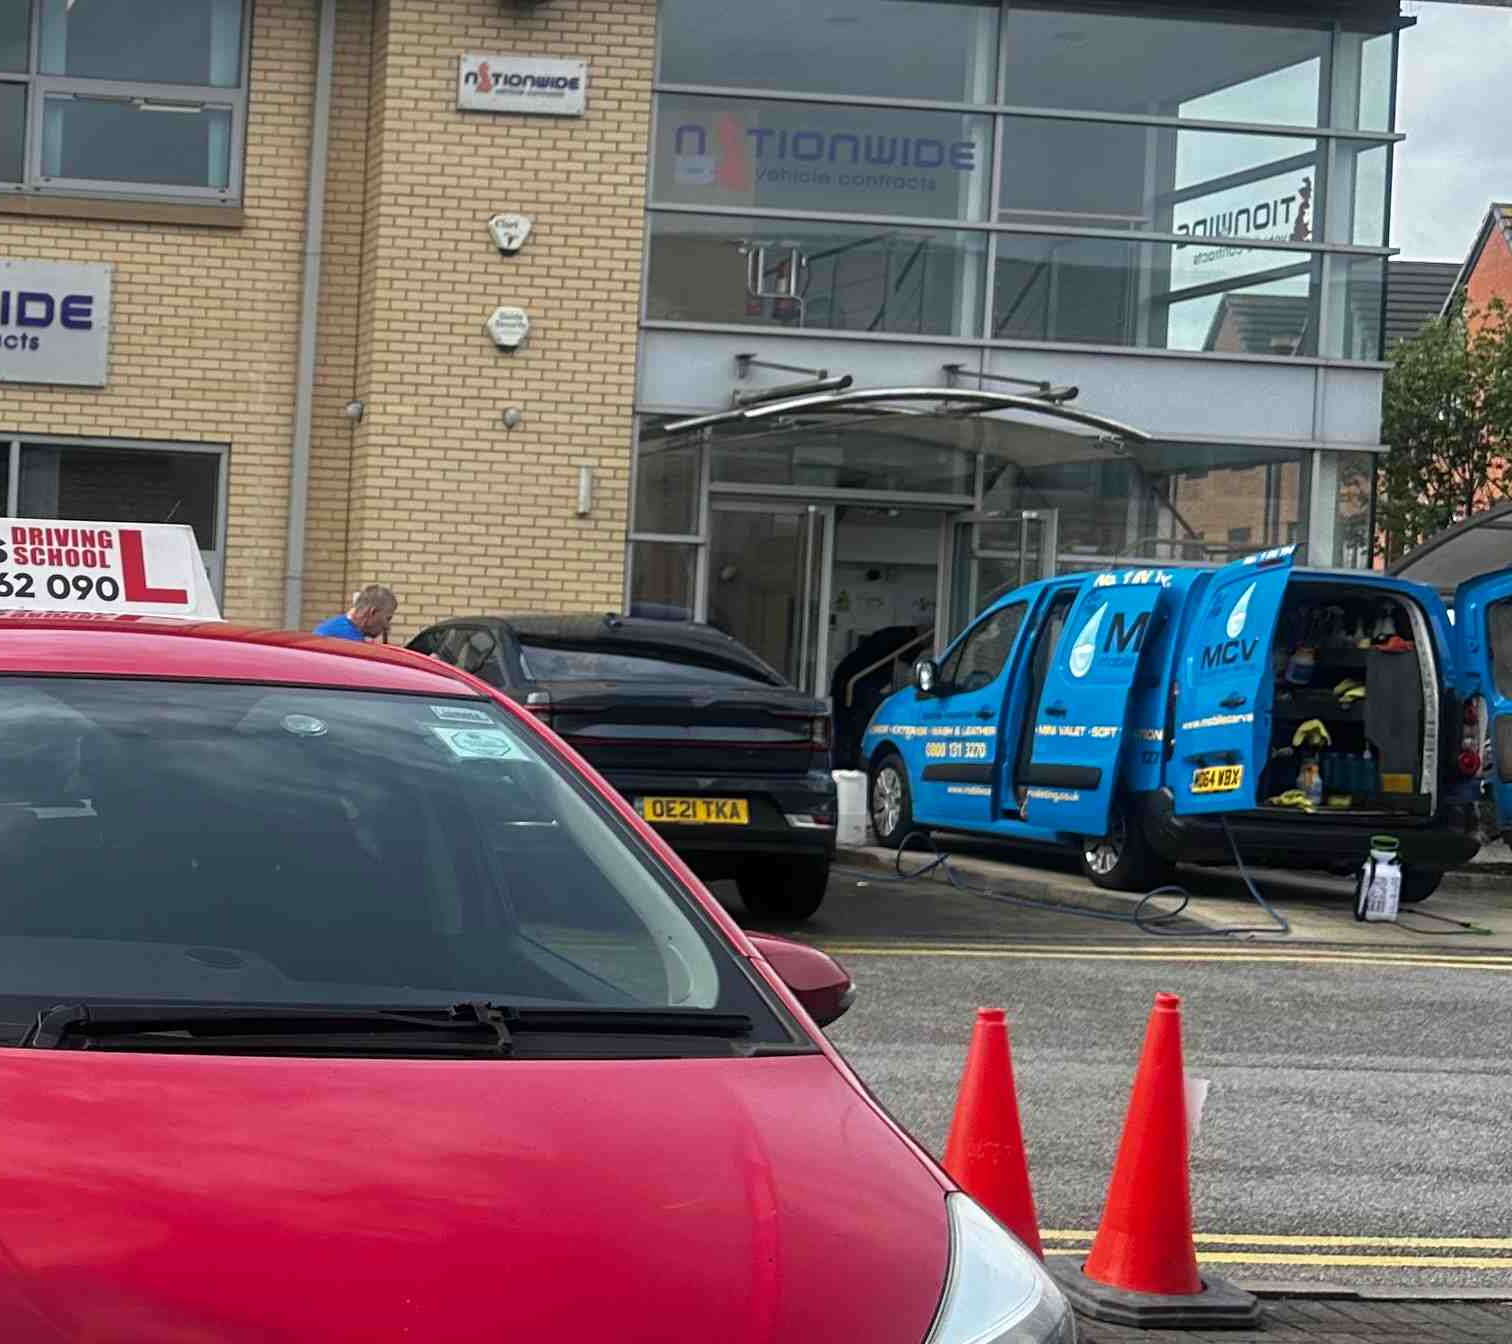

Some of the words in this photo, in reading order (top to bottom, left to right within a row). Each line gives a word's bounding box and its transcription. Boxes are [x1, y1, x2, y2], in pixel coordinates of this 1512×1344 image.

[11, 526, 113, 551] DRIVING
[13, 546, 111, 569] SCHOOL
[117, 528, 189, 605] L
[47, 573, 120, 602] 090
[1200, 639, 1259, 670] MCV
[698, 799, 742, 820] TKA
